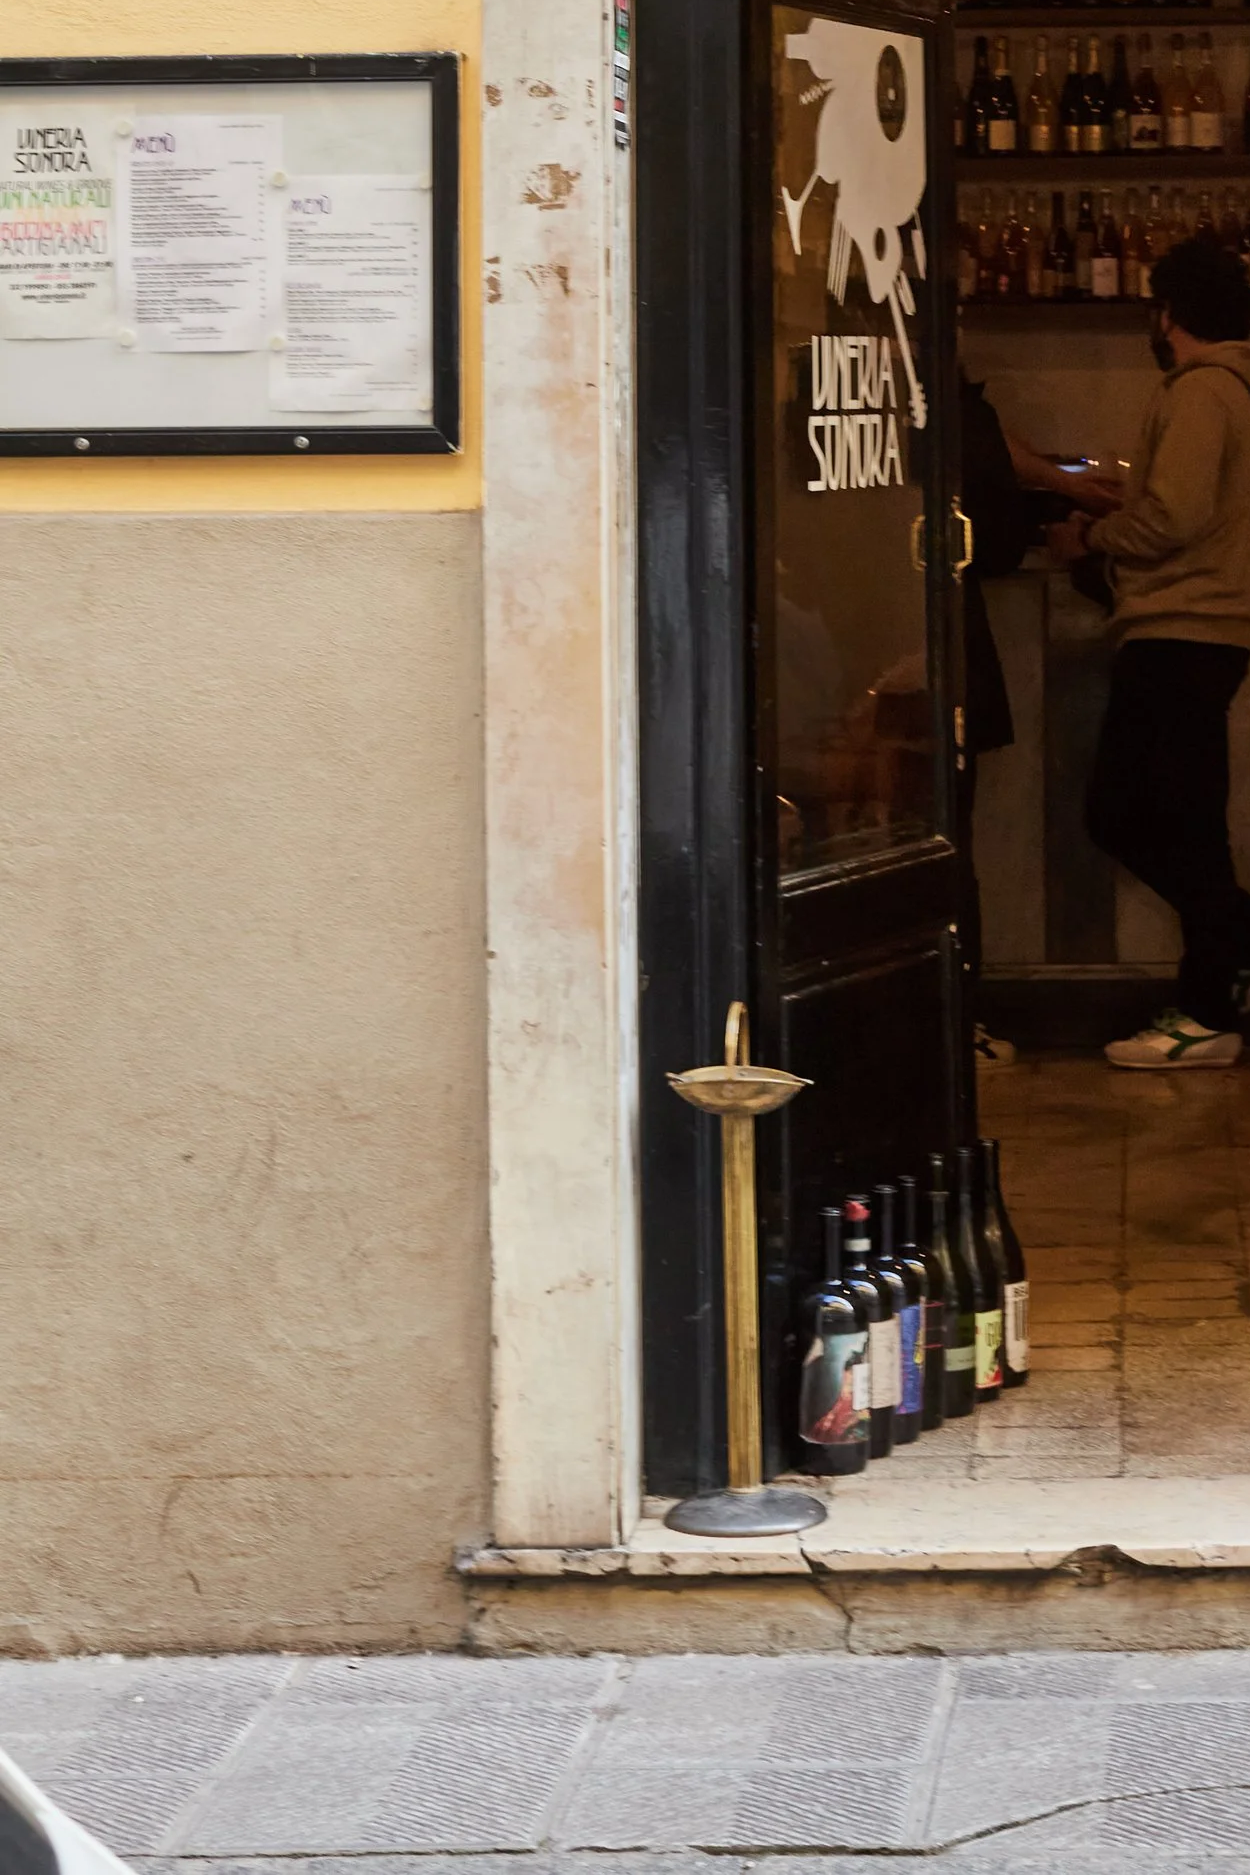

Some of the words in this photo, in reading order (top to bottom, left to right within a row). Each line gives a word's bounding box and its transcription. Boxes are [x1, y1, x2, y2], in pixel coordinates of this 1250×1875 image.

[13, 151, 93, 173] SONORA
[17, 127, 88, 149] VINERIA
[811, 335, 897, 411] VINERIA
[807, 413, 904, 492] SONORA
